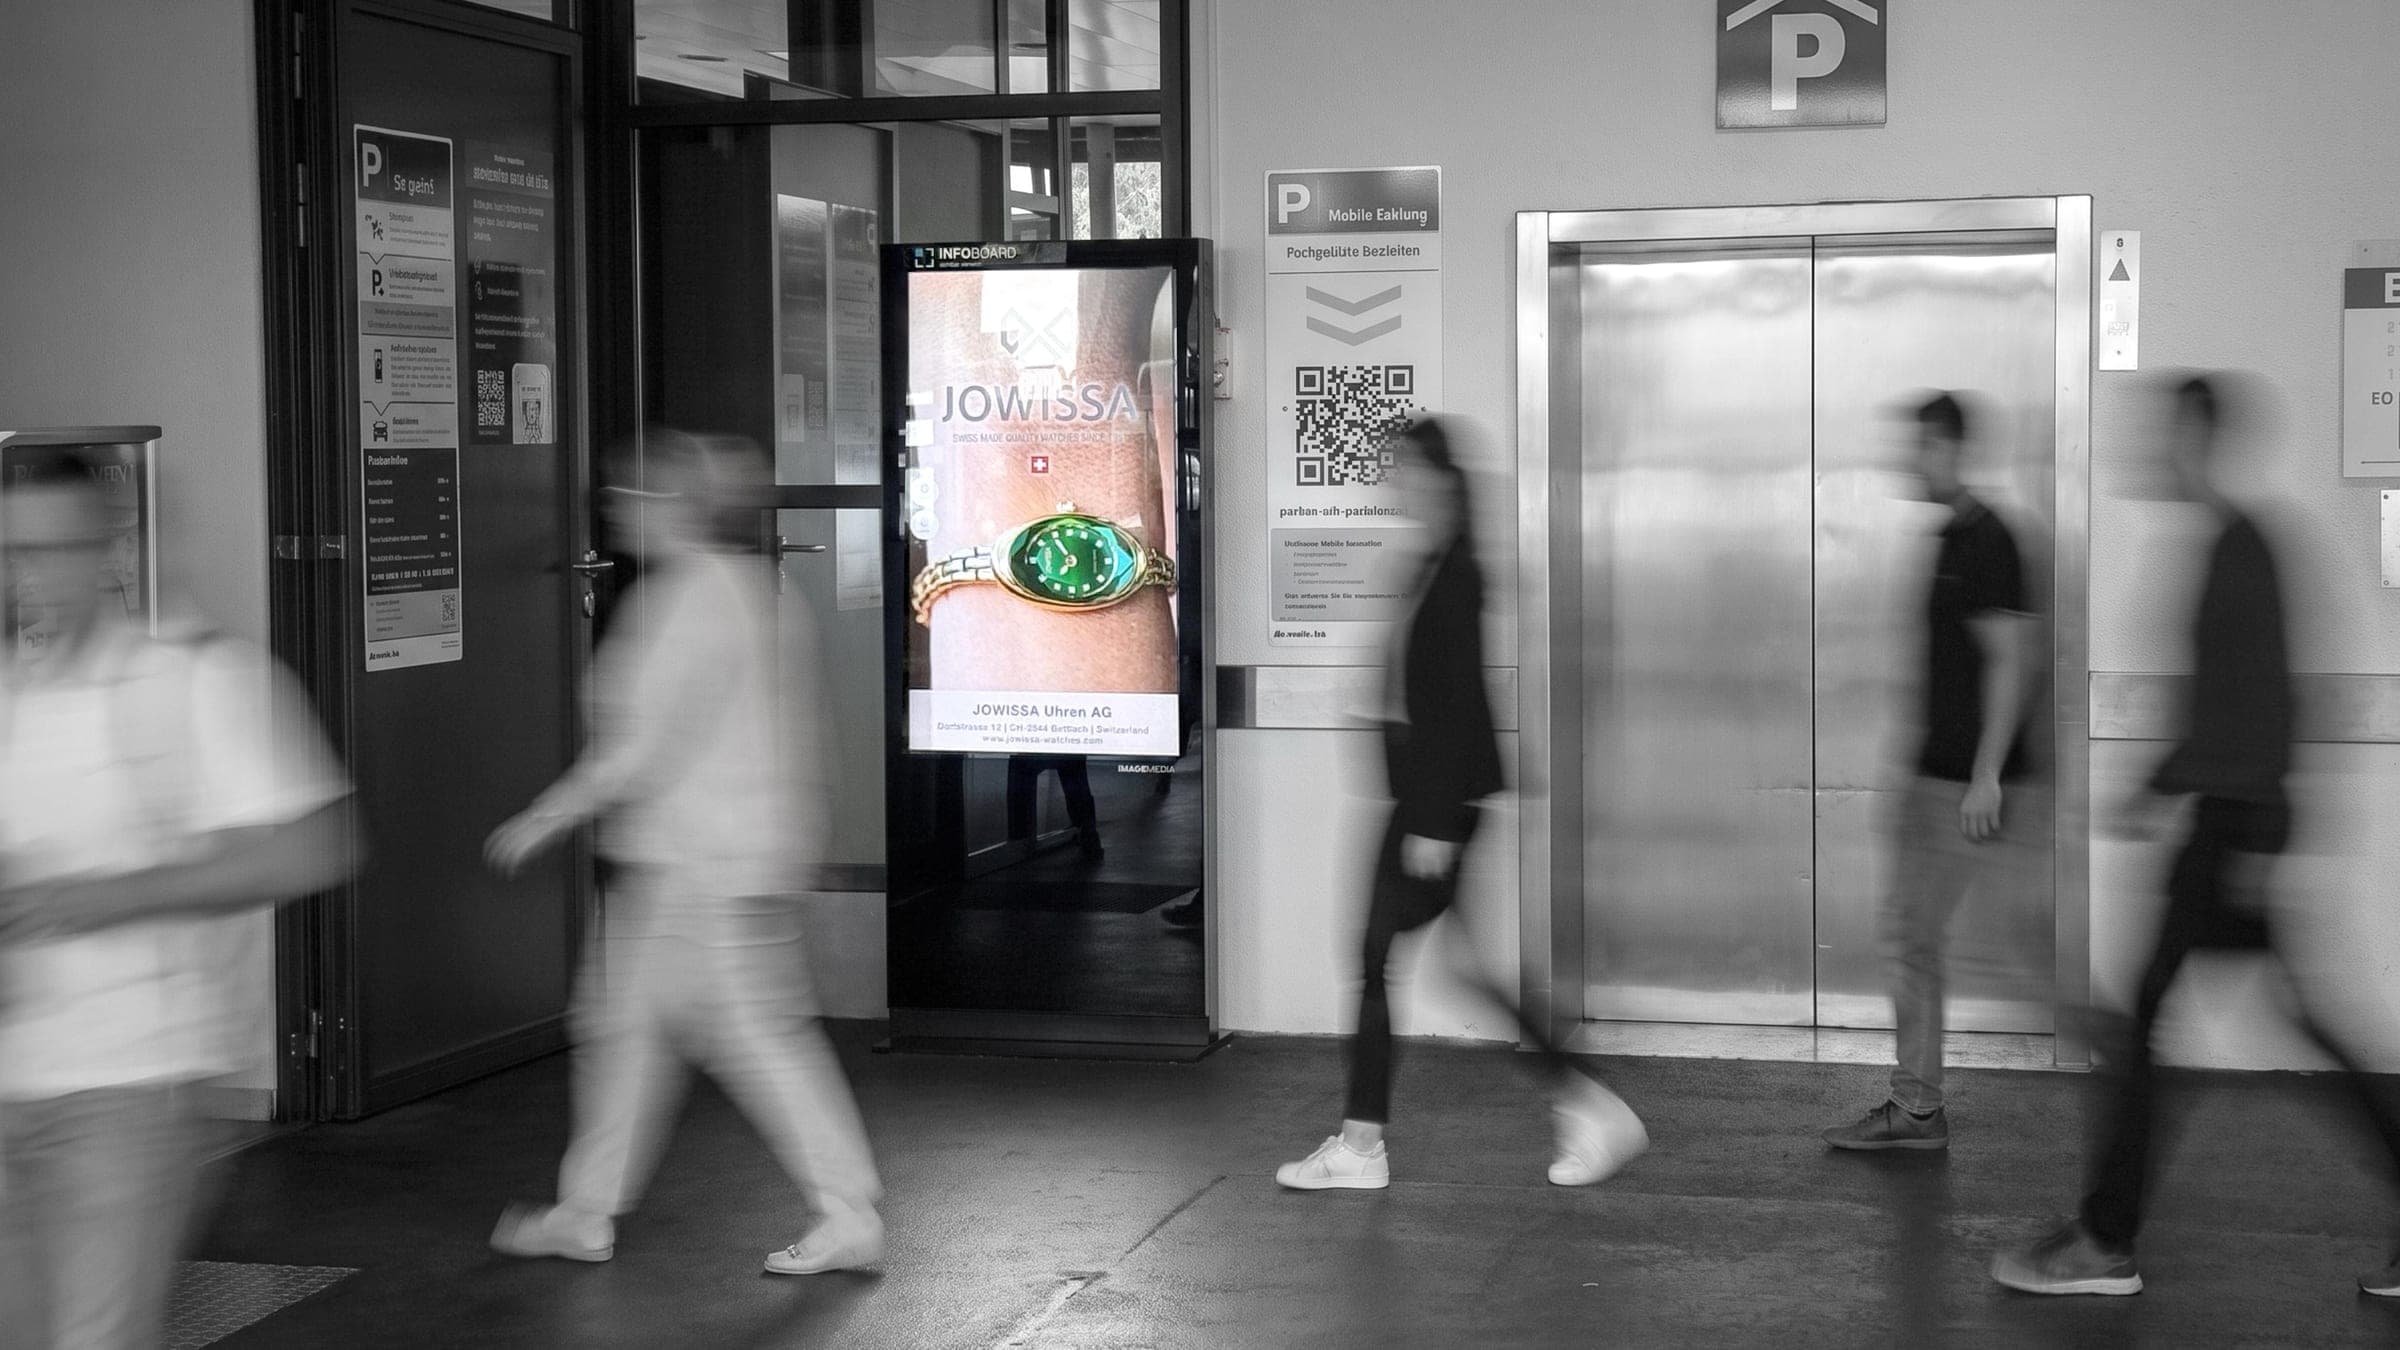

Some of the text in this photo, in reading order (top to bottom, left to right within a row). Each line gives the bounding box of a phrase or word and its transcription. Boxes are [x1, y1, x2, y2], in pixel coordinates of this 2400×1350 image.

[1772, 13, 1846, 111] P
[361, 142, 383, 187] P
[1278, 183, 1311, 224] P
[1328, 208, 1373, 221] Mobile
[938, 246, 1017, 260] INFOBOARD
[1362, 244, 1420, 257] Bezleiten
[942, 384, 1138, 423] JOWISSA
[972, 703, 1113, 719] JOWISSA Uhren AG
[991, 723, 1002, 732] 12
[1096, 725, 1150, 735] Switzerland
[1117, 764, 1176, 774] IMAGEMEDIA
